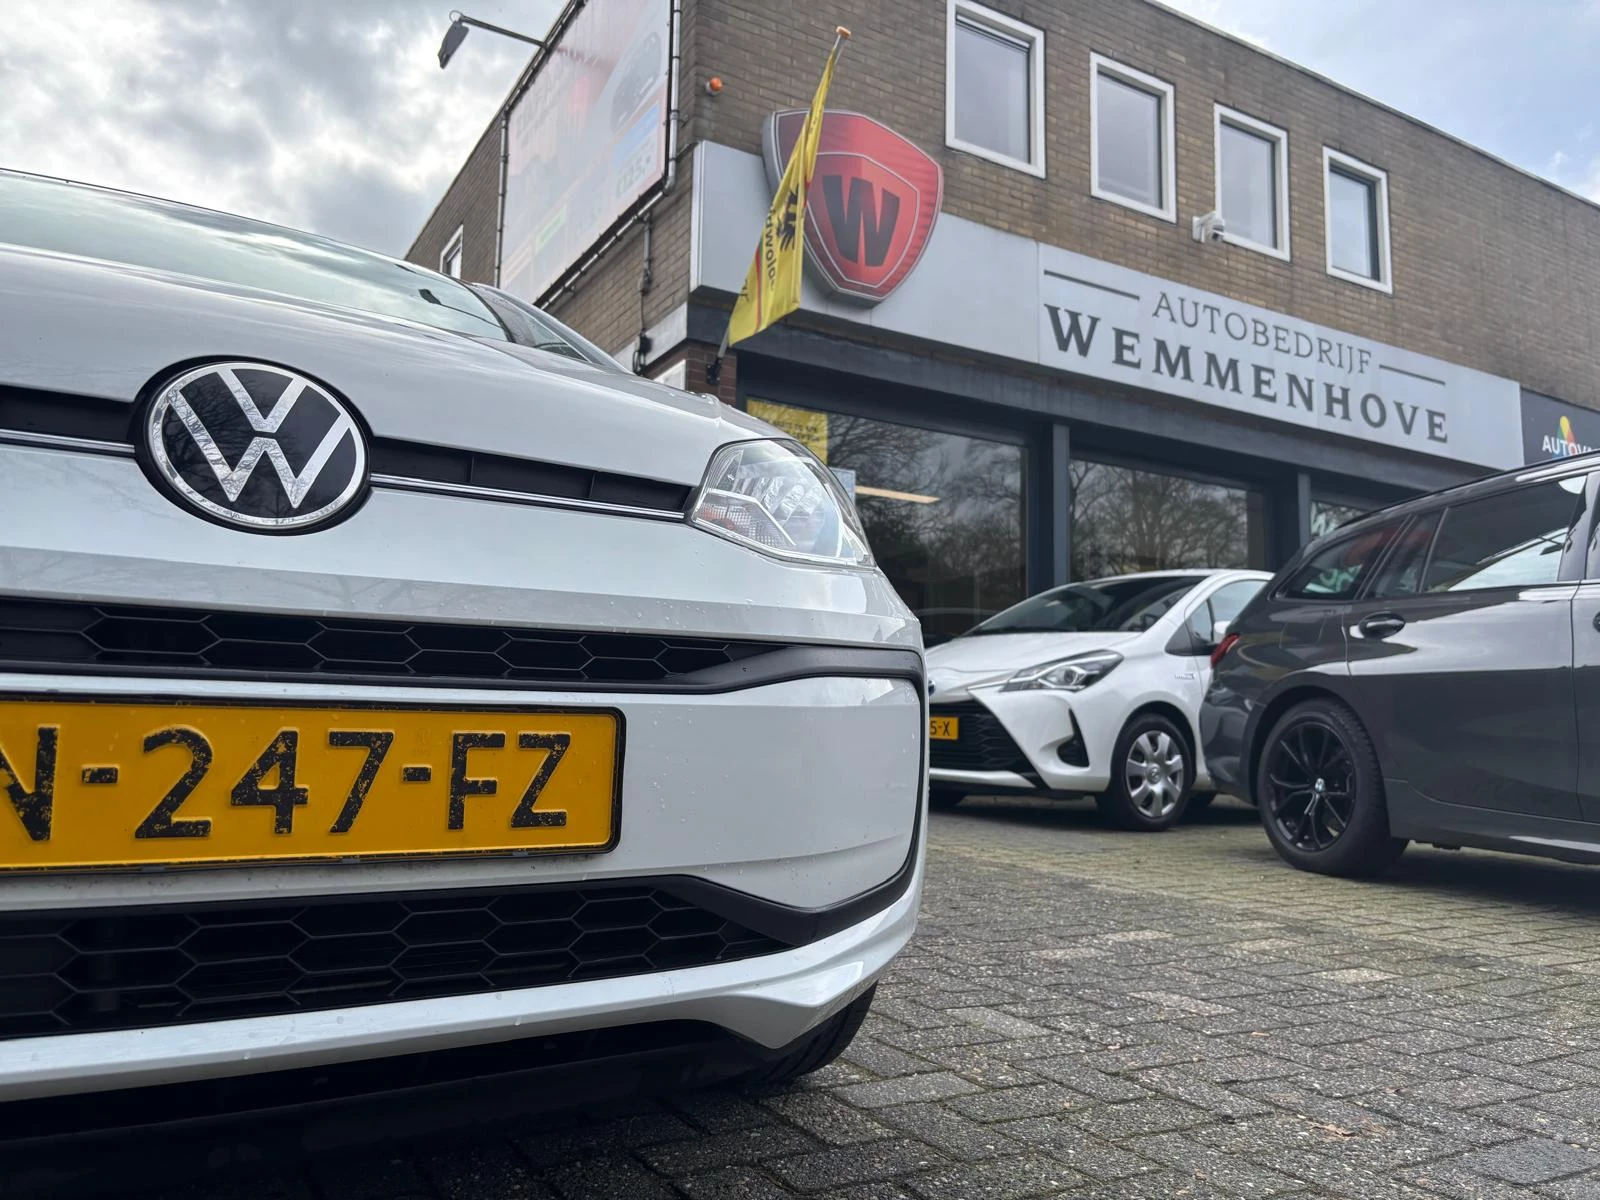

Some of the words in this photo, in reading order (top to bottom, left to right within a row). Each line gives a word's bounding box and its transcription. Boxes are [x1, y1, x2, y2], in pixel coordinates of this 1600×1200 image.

[822, 175, 900, 267] W
[1044, 303, 1449, 444] WEMMENHOVE
[1153, 292, 1372, 374] AUTOBEDRIJF
[1542, 434, 1592, 457] AUTOV
